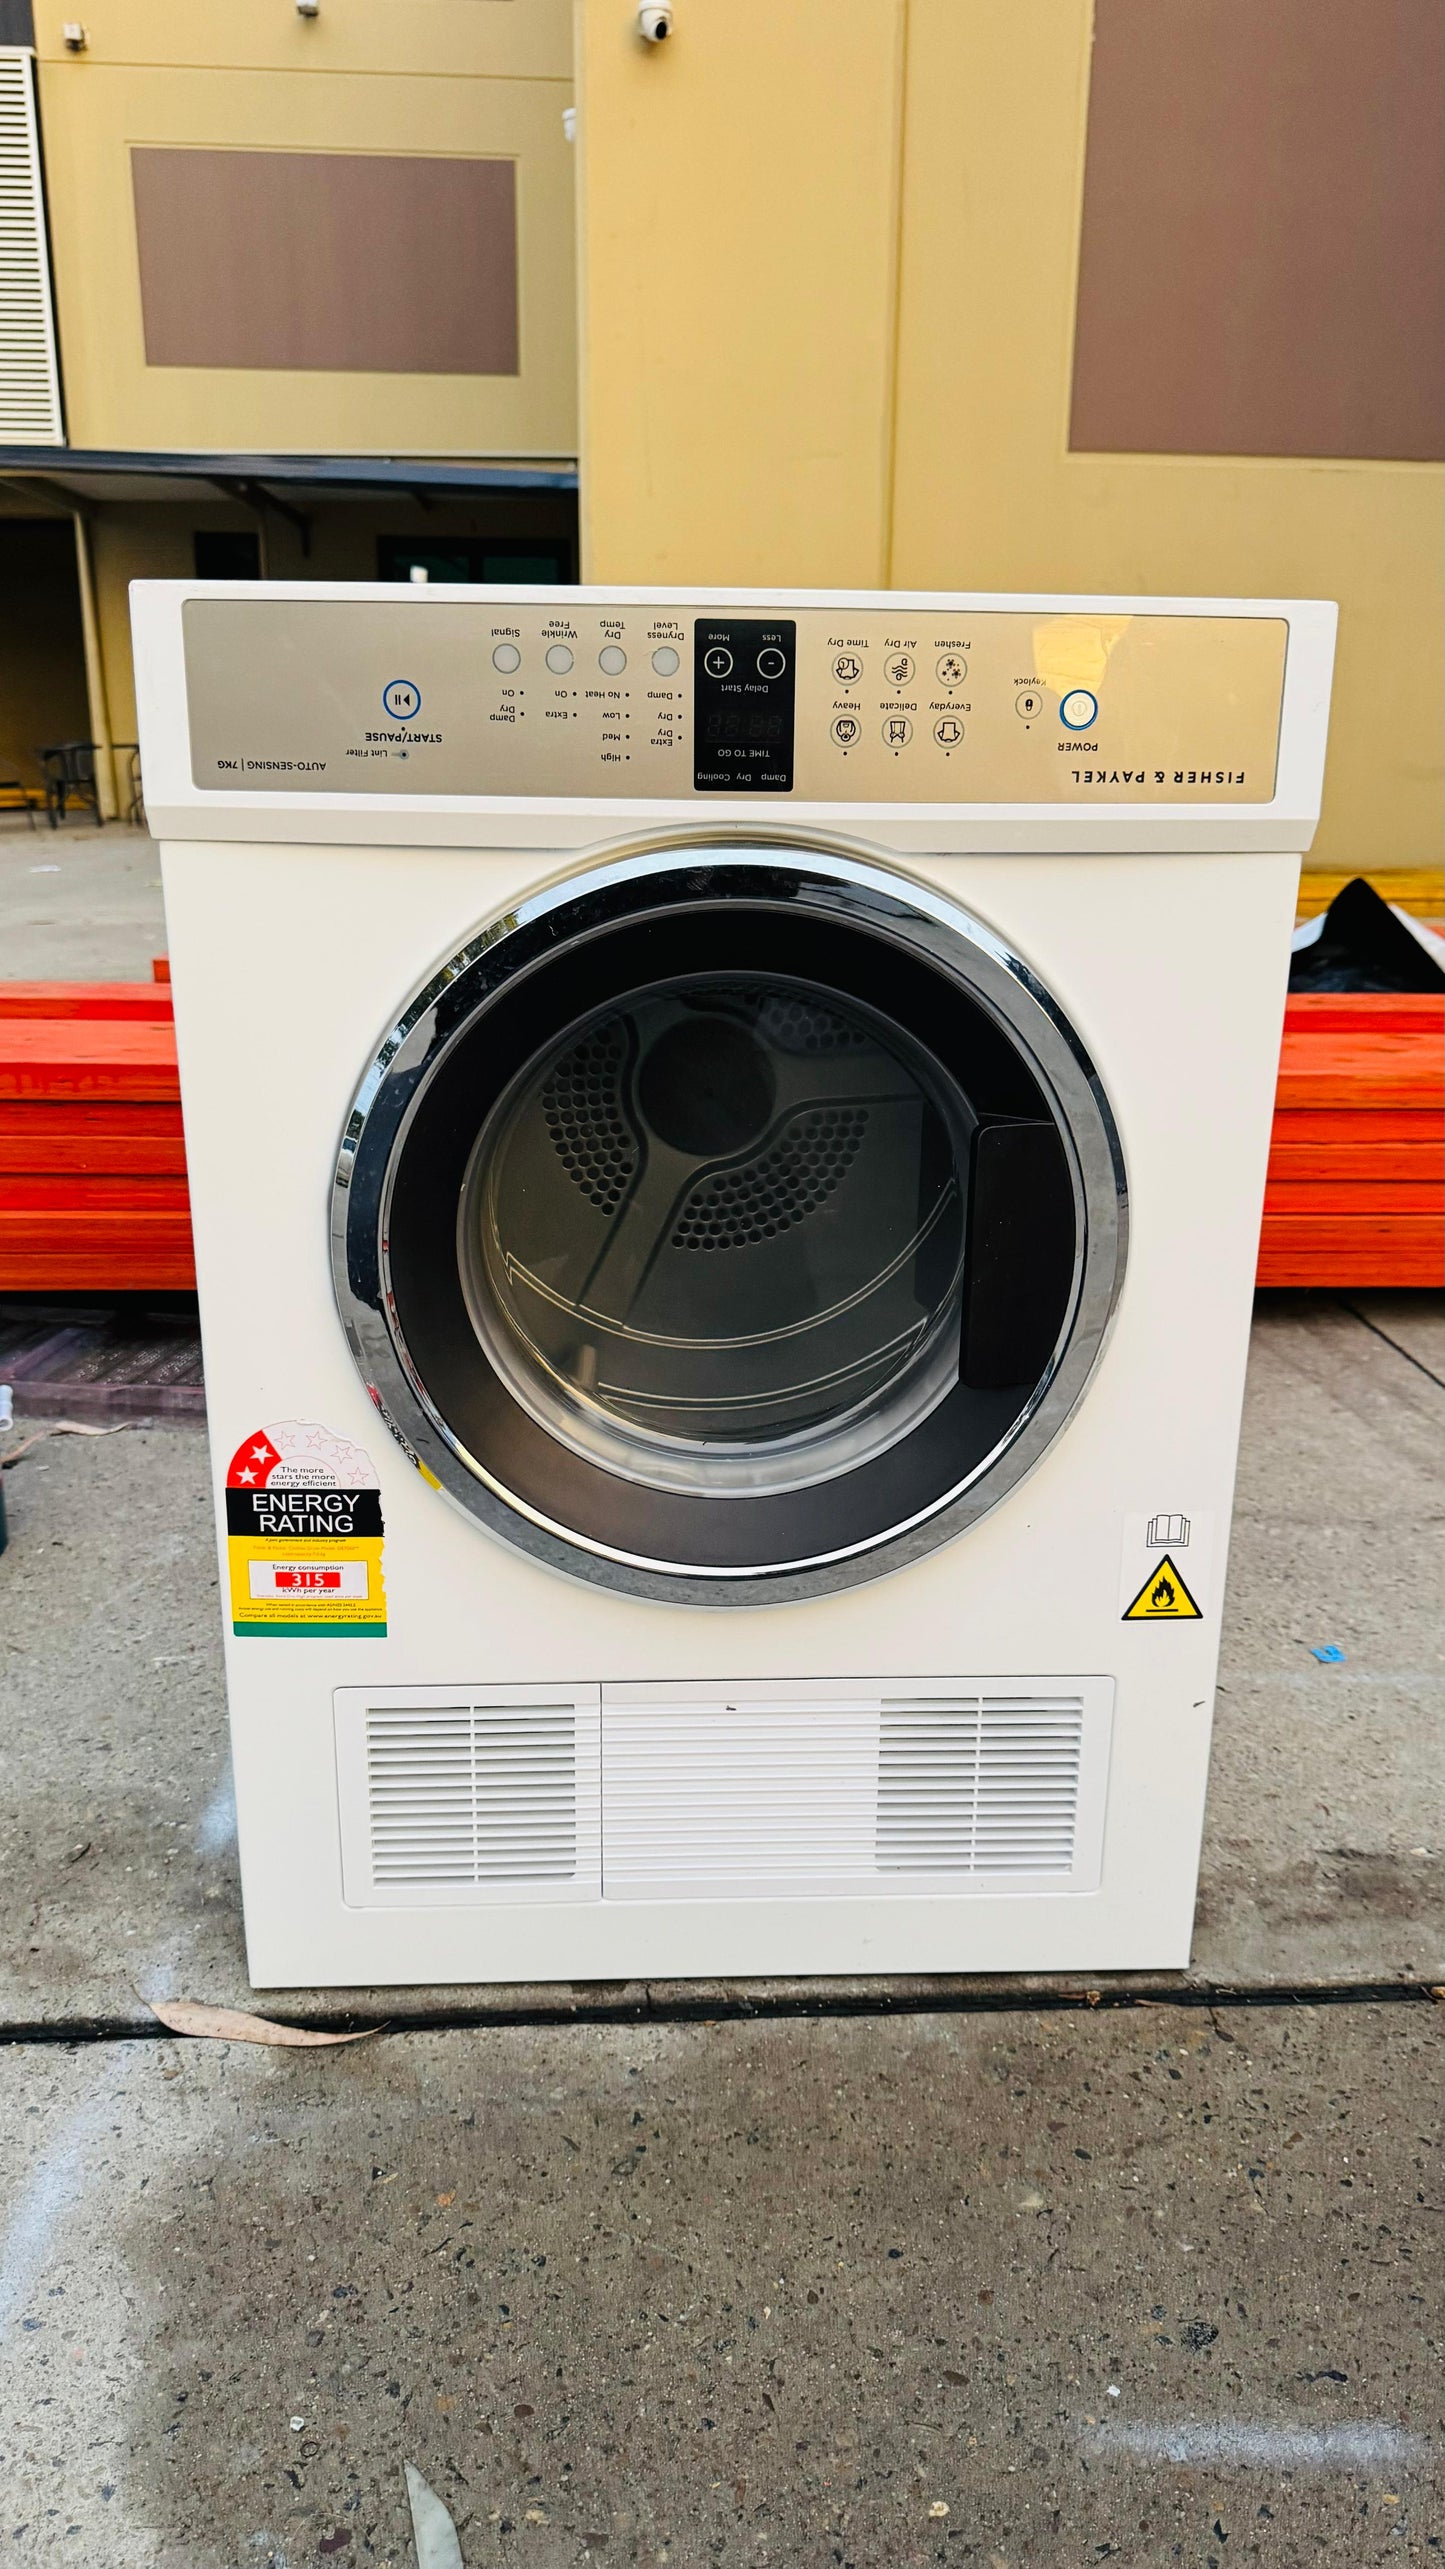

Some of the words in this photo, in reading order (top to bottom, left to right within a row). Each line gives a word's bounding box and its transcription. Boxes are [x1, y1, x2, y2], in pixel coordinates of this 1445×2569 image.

[548, 620, 570, 629] Free
[599, 619, 626, 629] Temp
[653, 622, 679, 630] Level
[491, 627, 521, 638] Signal
[541, 629, 578, 639] Wrinkle
[604, 628, 622, 640] Dry
[647, 630, 685, 641] Dryness
[708, 633, 730, 642] More
[762, 634, 782, 643] Less
[827, 637, 844, 648] Dry
[846, 639, 870, 648] Time
[884, 638, 901, 649] Dry
[903, 640, 918, 649] Air
[934, 640, 971, 650] Freshen
[1013, 677, 1046, 687] Keylock
[501, 689, 515, 698] On
[721, 684, 743, 694] Start
[746, 684, 769, 694] Delay
[554, 690, 568, 699] On
[585, 691, 606, 699] Heat
[609, 691, 621, 699] No
[647, 691, 673, 701] Damp
[499, 704, 516, 714] Dry
[832, 700, 861, 711] Heavy
[879, 702, 918, 712] Delicate
[928, 701, 972, 712] Everyday
[489, 713, 516, 723] Damp
[545, 711, 568, 720] Extra
[602, 712, 621, 720] Low
[657, 711, 673, 722] Dry
[364, 731, 443, 744] START/PAUSE
[602, 733, 621, 742] Med
[657, 728, 673, 738] Dry
[650, 738, 673, 747] Extra
[1057, 742, 1099, 752] POWER
[345, 749, 369, 758] Filter
[370, 749, 388, 758] Lint
[600, 752, 621, 762] High
[717, 748, 732, 757] GO
[733, 749, 747, 758] TO
[749, 749, 771, 758] TIME
[217, 760, 238, 770] 7KG
[246, 760, 327, 771] AUTO-SENSING
[697, 772, 731, 782] Cooling
[736, 772, 752, 782] Dry
[760, 773, 787, 783] Damp
[1071, 770, 1145, 784] PAYKEL
[1154, 770, 1166, 784] &
[1173, 771, 1245, 784] FISHER
[253, 1494, 360, 1512] ENERGY
[260, 1515, 353, 1532] RATING
[292, 1574, 324, 1586] 315
